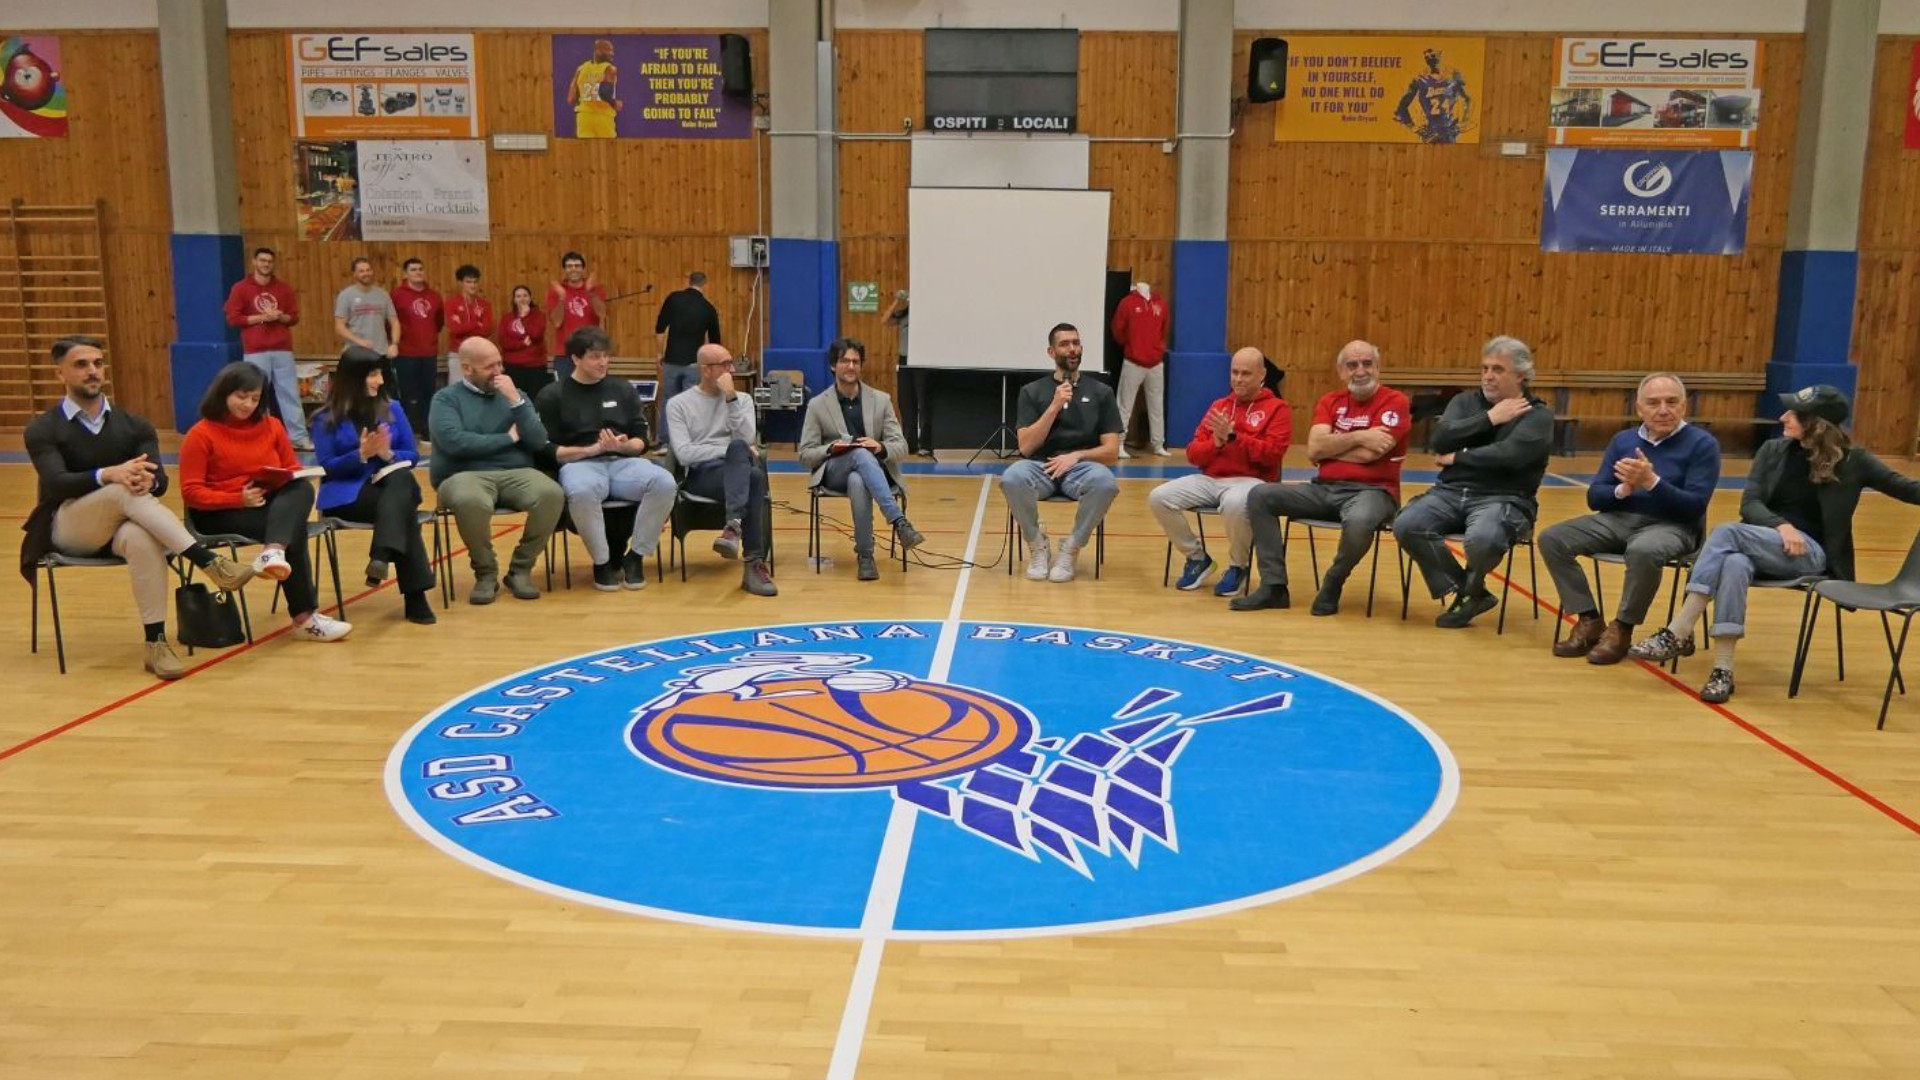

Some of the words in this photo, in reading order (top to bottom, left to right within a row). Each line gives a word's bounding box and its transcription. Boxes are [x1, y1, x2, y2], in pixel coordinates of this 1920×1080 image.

[671, 48, 709, 60] YOU'RE
[1303, 56, 1323, 68] YOU
[1327, 56, 1358, 68] DON'T
[1361, 57, 1402, 69] BELIEVE
[301, 69, 326, 77] PIPES
[335, 69, 376, 77] FITTINGS
[384, 69, 426, 77] FLANGES
[435, 69, 469, 77] VALVES
[640, 63, 678, 75] AFRAID
[681, 63, 694, 75] TO
[696, 63, 722, 76] FAIL,
[649, 78, 675, 90] THEN
[677, 78, 714, 90] YOU'RE
[1308, 72, 1319, 83] IN
[1321, 72, 1377, 84] YOURSELF,
[1301, 87, 1316, 98] NO
[1320, 87, 1339, 98] ONE
[1342, 87, 1366, 98] WILL
[1369, 87, 1385, 98] DO
[654, 93, 709, 105] PROBABLY
[1310, 102, 1321, 113] IT
[1323, 102, 1344, 113] FOR
[643, 108, 675, 120] GOING
[678, 108, 691, 120] TO
[933, 116, 987, 129] OSPITI
[1013, 116, 1069, 129] LOCALI
[375, 152, 433, 162] TEATRO
[366, 202, 415, 216] Aperitivi
[425, 202, 480, 214] Cocktails
[1599, 204, 1691, 216] SERRAMENTI
[967, 624, 1300, 683] BASKET
[439, 623, 931, 739] CASTELLANA
[422, 752, 562, 826] ASD
